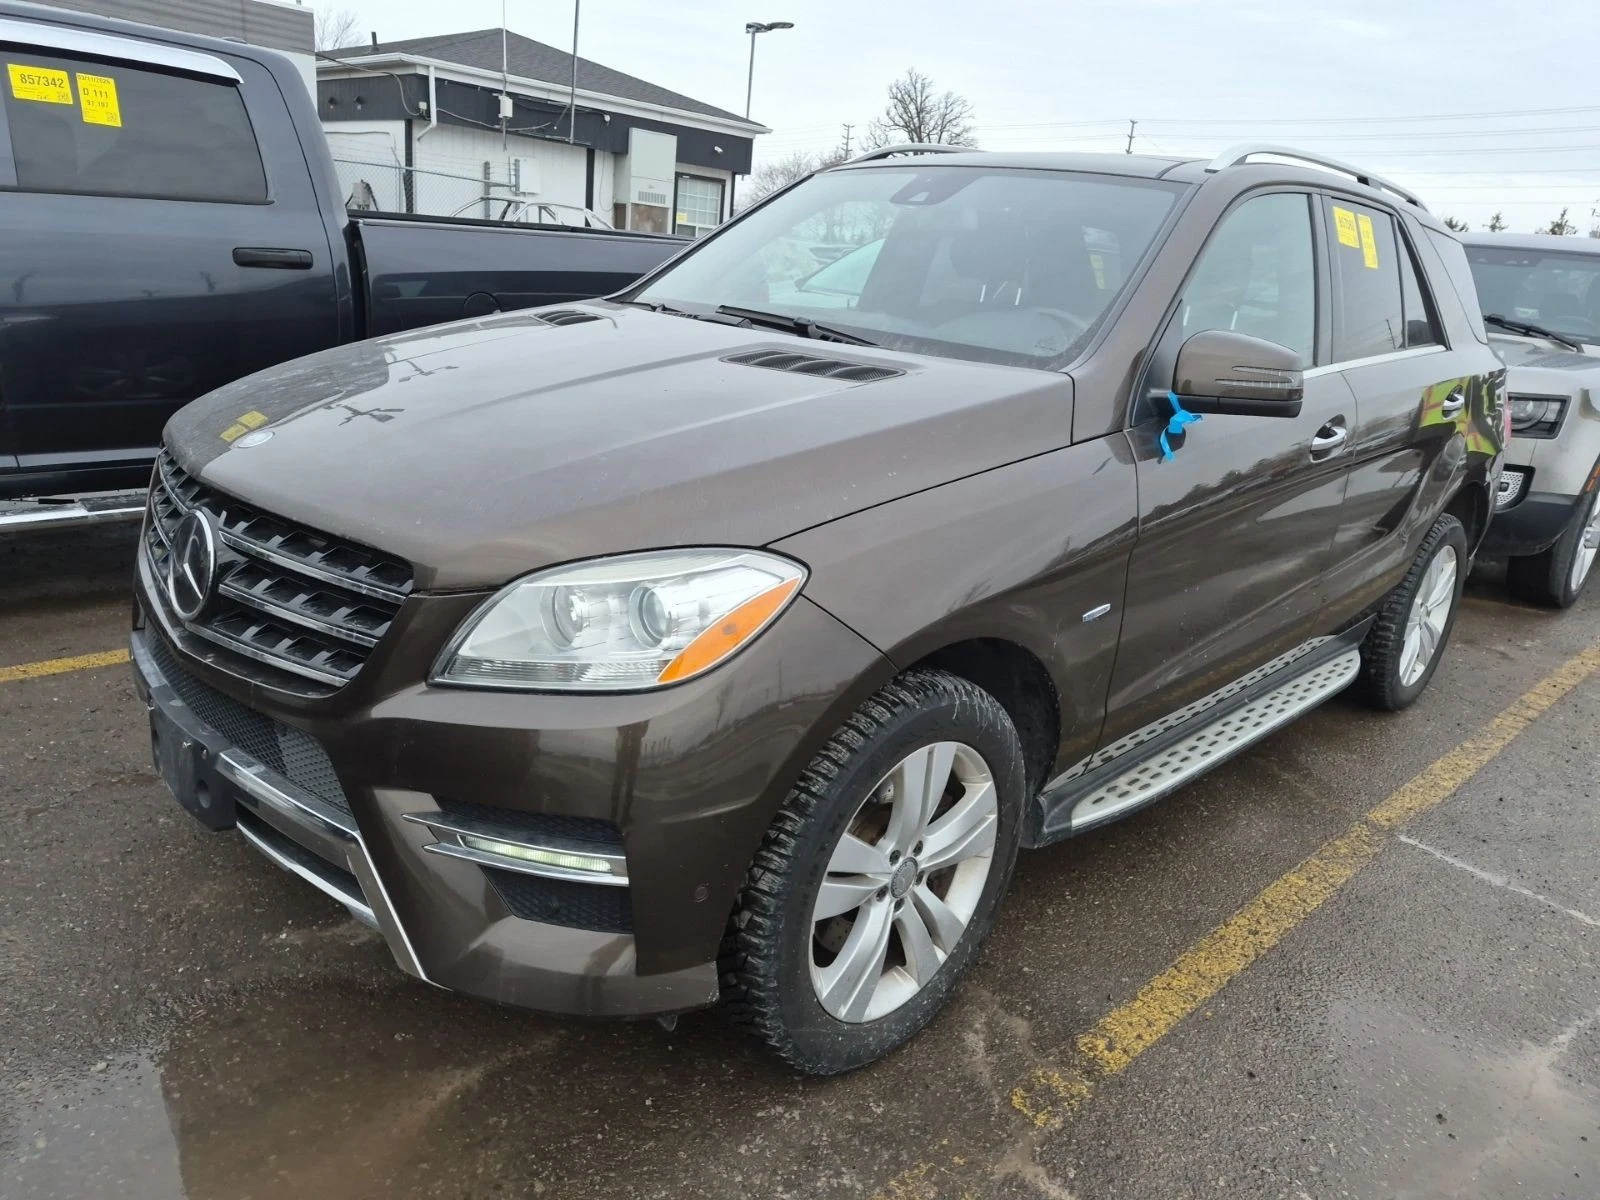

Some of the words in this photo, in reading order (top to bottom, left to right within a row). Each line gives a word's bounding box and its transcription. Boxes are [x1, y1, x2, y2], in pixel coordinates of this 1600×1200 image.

[20, 73, 65, 89] 857342
[83, 87, 90, 96] D
[93, 89, 108, 99] 111
